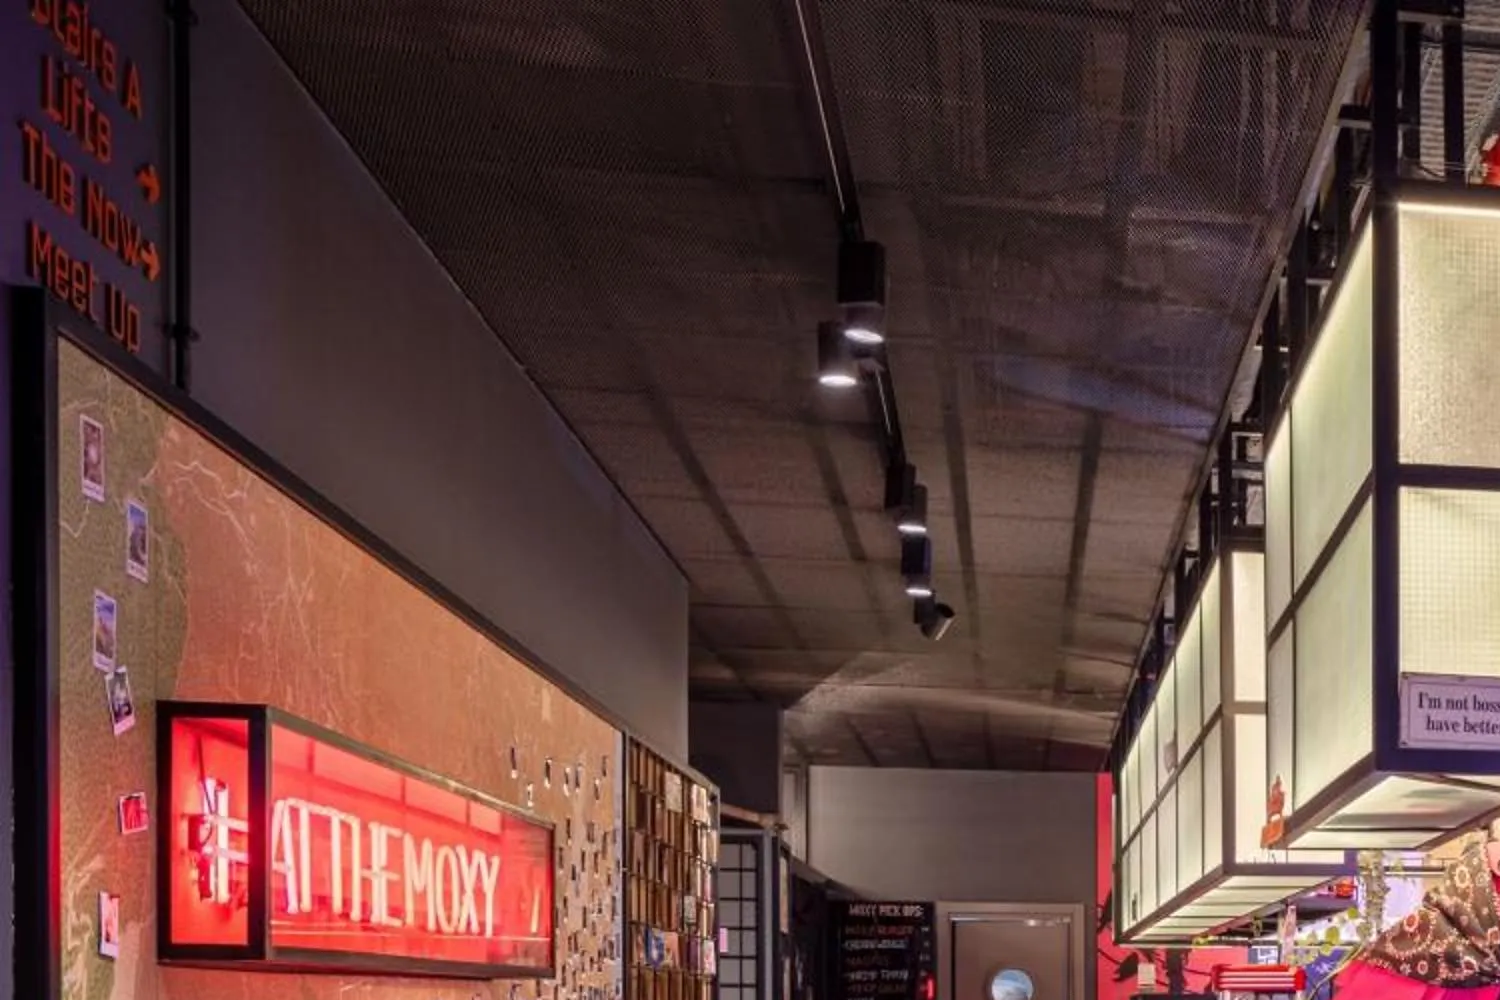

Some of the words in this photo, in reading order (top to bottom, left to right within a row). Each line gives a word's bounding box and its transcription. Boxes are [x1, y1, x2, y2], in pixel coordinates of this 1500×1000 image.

[46, 56, 112, 164] Lifts
[23, 122, 76, 216] The
[86, 180, 141, 266] Now
[31, 221, 98, 322] Meet
[111, 288, 140, 352] Up
[1418, 691, 1441, 708] I'm
[1446, 697, 1469, 711] not
[1426, 714, 1461, 733] have
